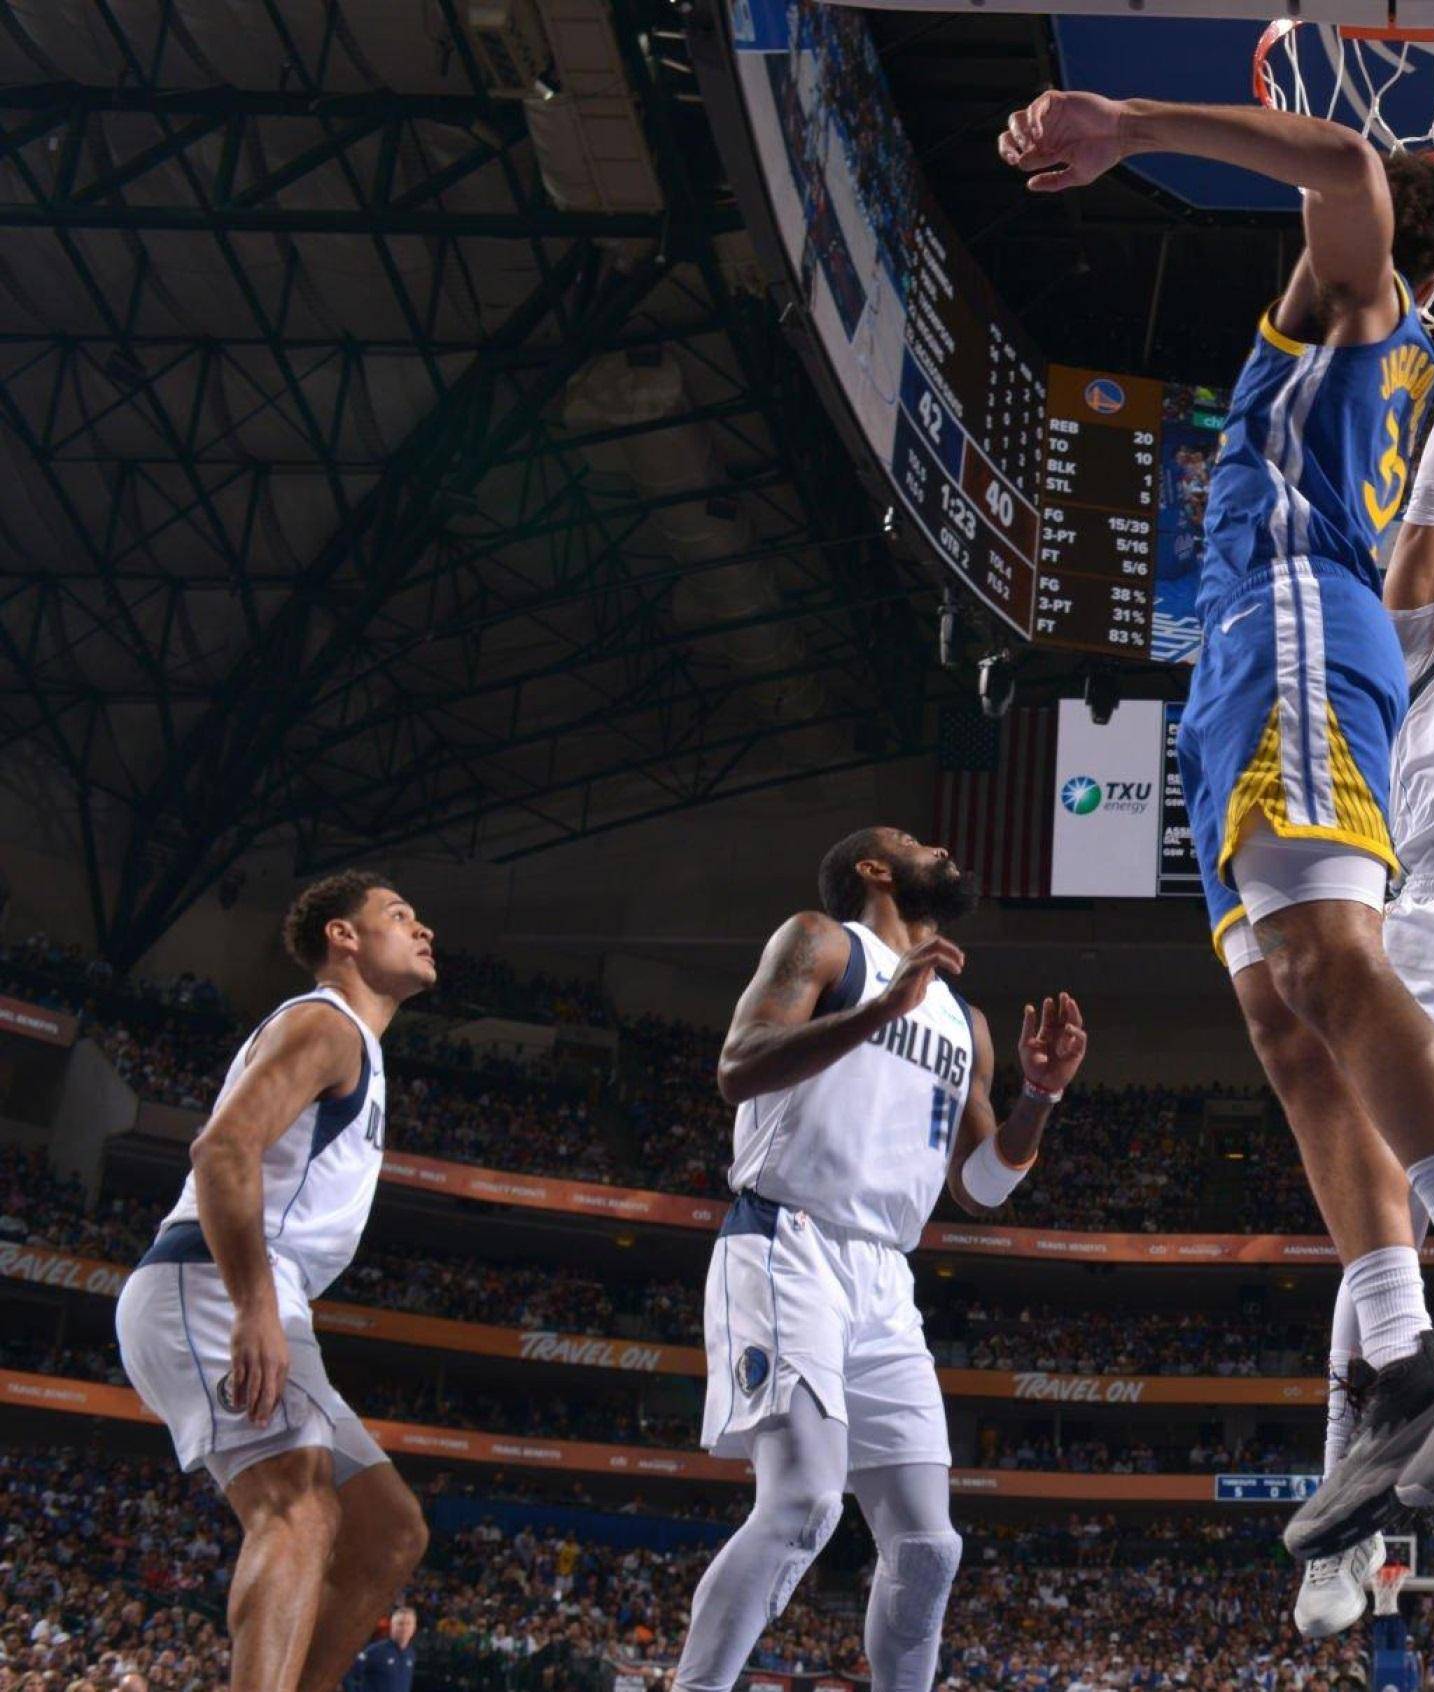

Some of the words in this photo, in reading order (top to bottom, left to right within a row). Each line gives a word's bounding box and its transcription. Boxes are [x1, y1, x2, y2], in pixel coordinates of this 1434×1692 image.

[919, 391, 943, 444] 42
[1204, 416, 1225, 427] chi
[1049, 419, 1079, 434] REB
[1134, 431, 1154, 446] 20
[1049, 437, 1069, 452] TO
[1135, 452, 1153, 465] 10
[1047, 459, 1076, 475] BLK
[1144, 475, 1152, 487] 1
[986, 481, 1013, 527] 40
[1046, 477, 1072, 493] STL
[1140, 492, 1150, 505] 5
[941, 484, 976, 540] 1:23
[1043, 508, 1064, 523] FG
[1108, 517, 1149, 534] 15/39
[941, 527, 960, 560] QTR
[1042, 527, 1077, 544] 3-PT
[1116, 538, 1149, 555] 5/16
[1041, 548, 1061, 563] FT
[1122, 560, 1148, 576] 5/6
[1039, 577, 1060, 592] FG
[1038, 597, 1072, 614] 3-PT
[1036, 619, 1056, 633] FT
[1106, 782, 1151, 800] TXU
[1103, 801, 1148, 814] energy
[942, 1233, 978, 1245] LOYALTY
[980, 1236, 1012, 1247] POINTS
[1036, 1240, 1067, 1250] TRAVEL
[1068, 1243, 1107, 1253] BENEFITS
[1284, 1246, 1338, 1255] AADVANTAG
[0, 1240, 85, 1290] RAVEL
[519, 1332, 614, 1367] TRAVEL
[620, 1346, 660, 1372] ON
[1013, 1372, 1101, 1402] TRAVEL
[1106, 1380, 1144, 1403] ON
[1270, 1487, 1279, 1498] 0
